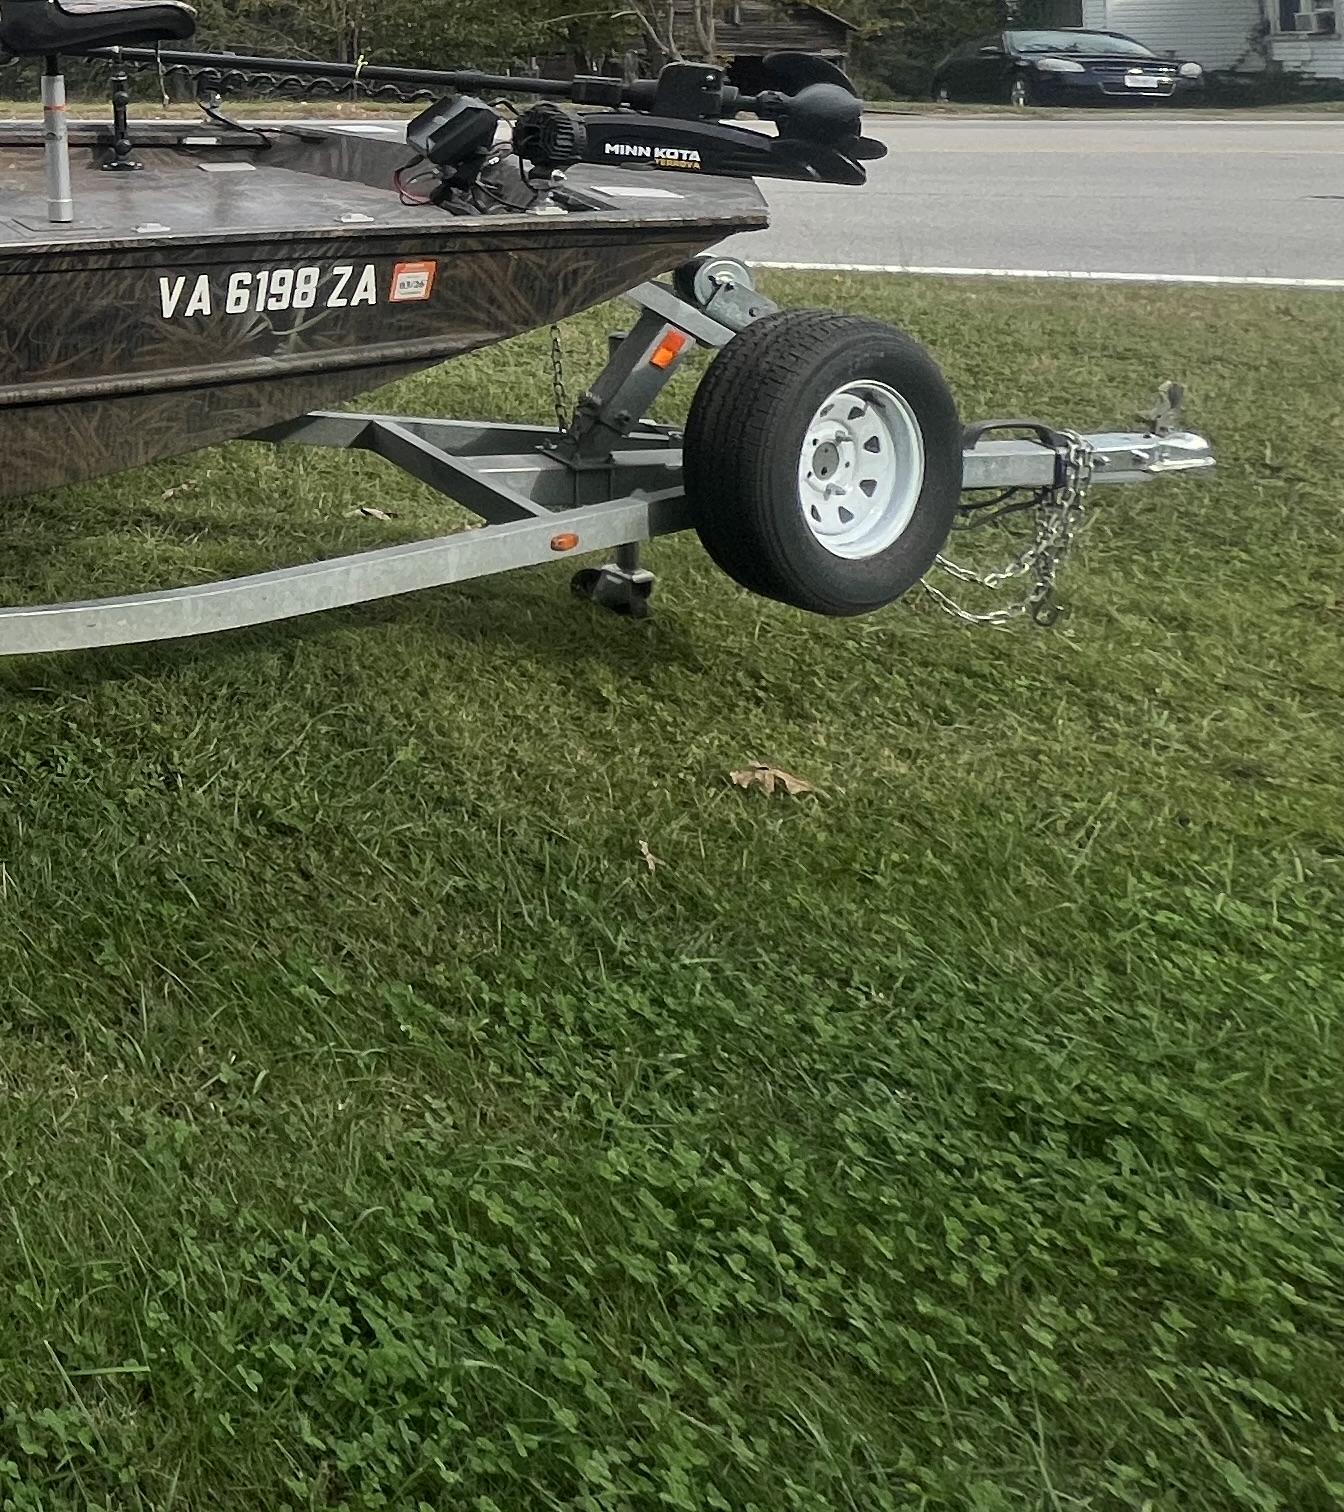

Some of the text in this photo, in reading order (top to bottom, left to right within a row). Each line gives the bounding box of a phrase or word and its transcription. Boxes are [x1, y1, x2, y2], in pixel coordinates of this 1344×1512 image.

[604, 143, 701, 162] MINN KOTA
[160, 264, 377, 318] VA 6198 ZA
